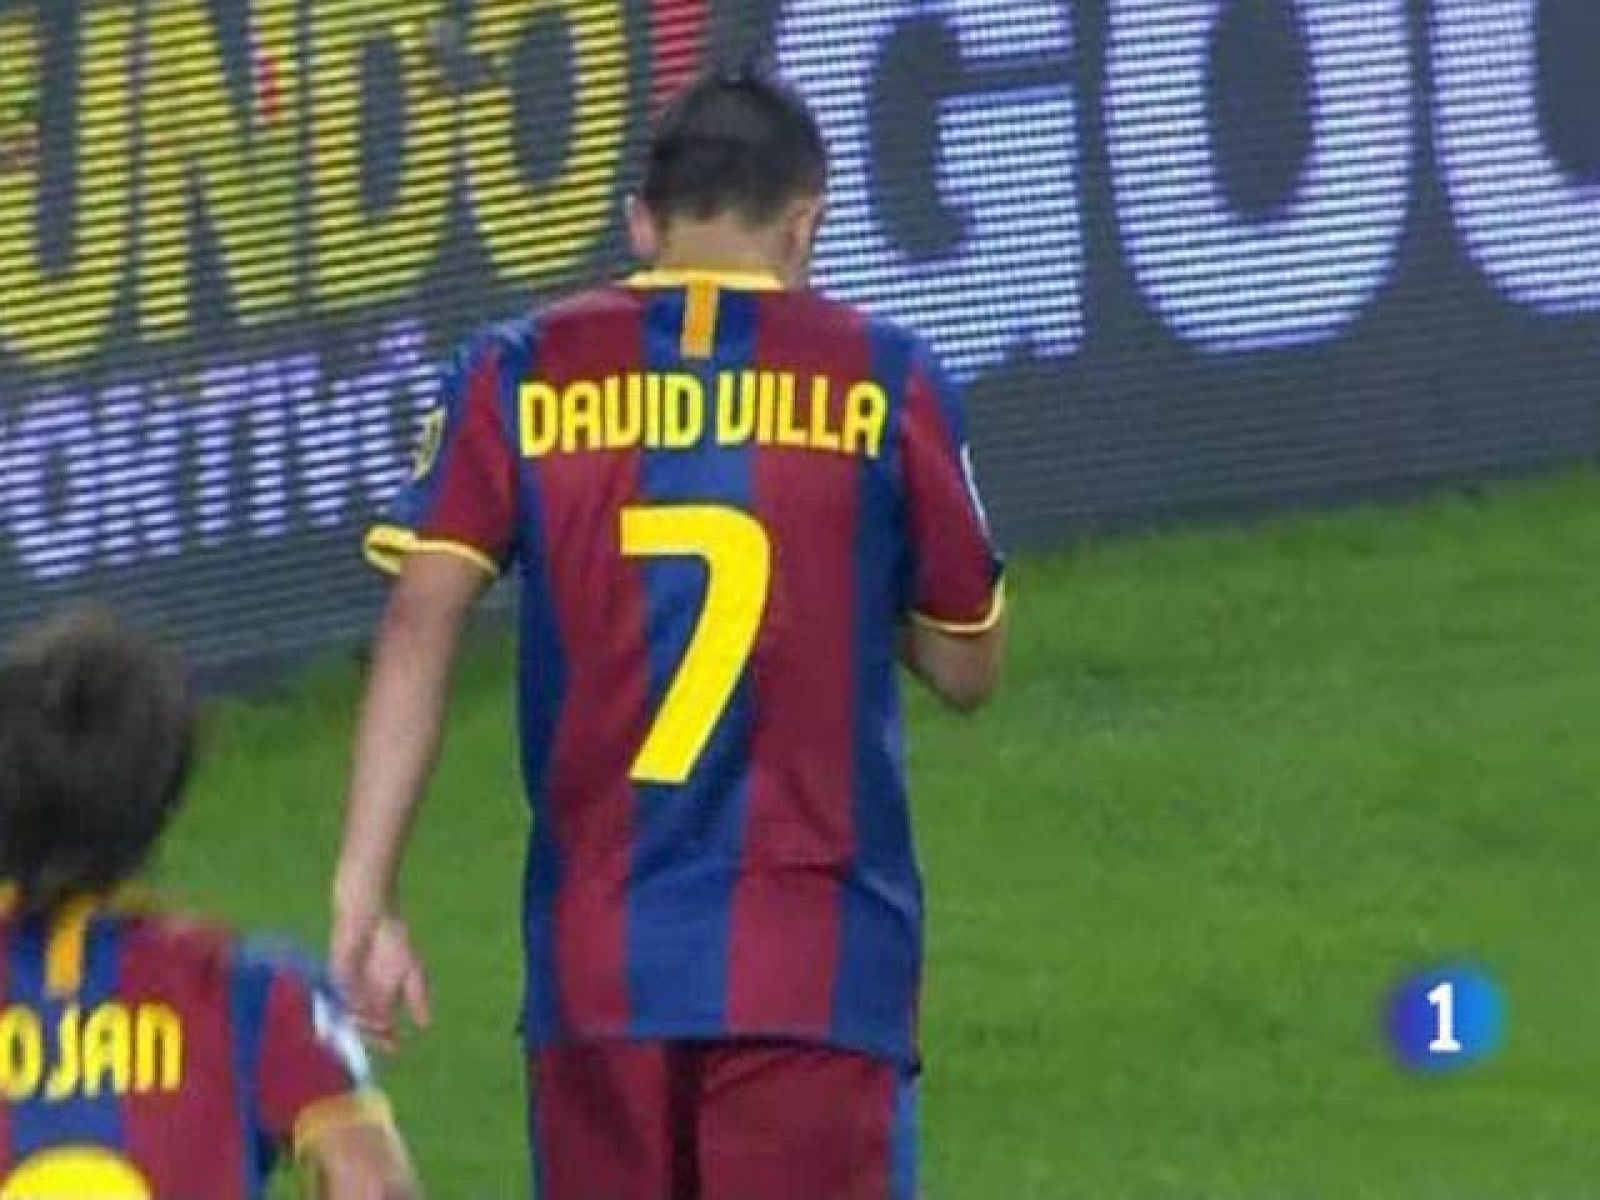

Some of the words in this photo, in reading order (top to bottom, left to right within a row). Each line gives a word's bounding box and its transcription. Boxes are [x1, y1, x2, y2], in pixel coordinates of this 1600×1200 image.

[519, 371, 705, 458] DAVID
[716, 370, 888, 458] VILLA
[620, 505, 770, 785] 7
